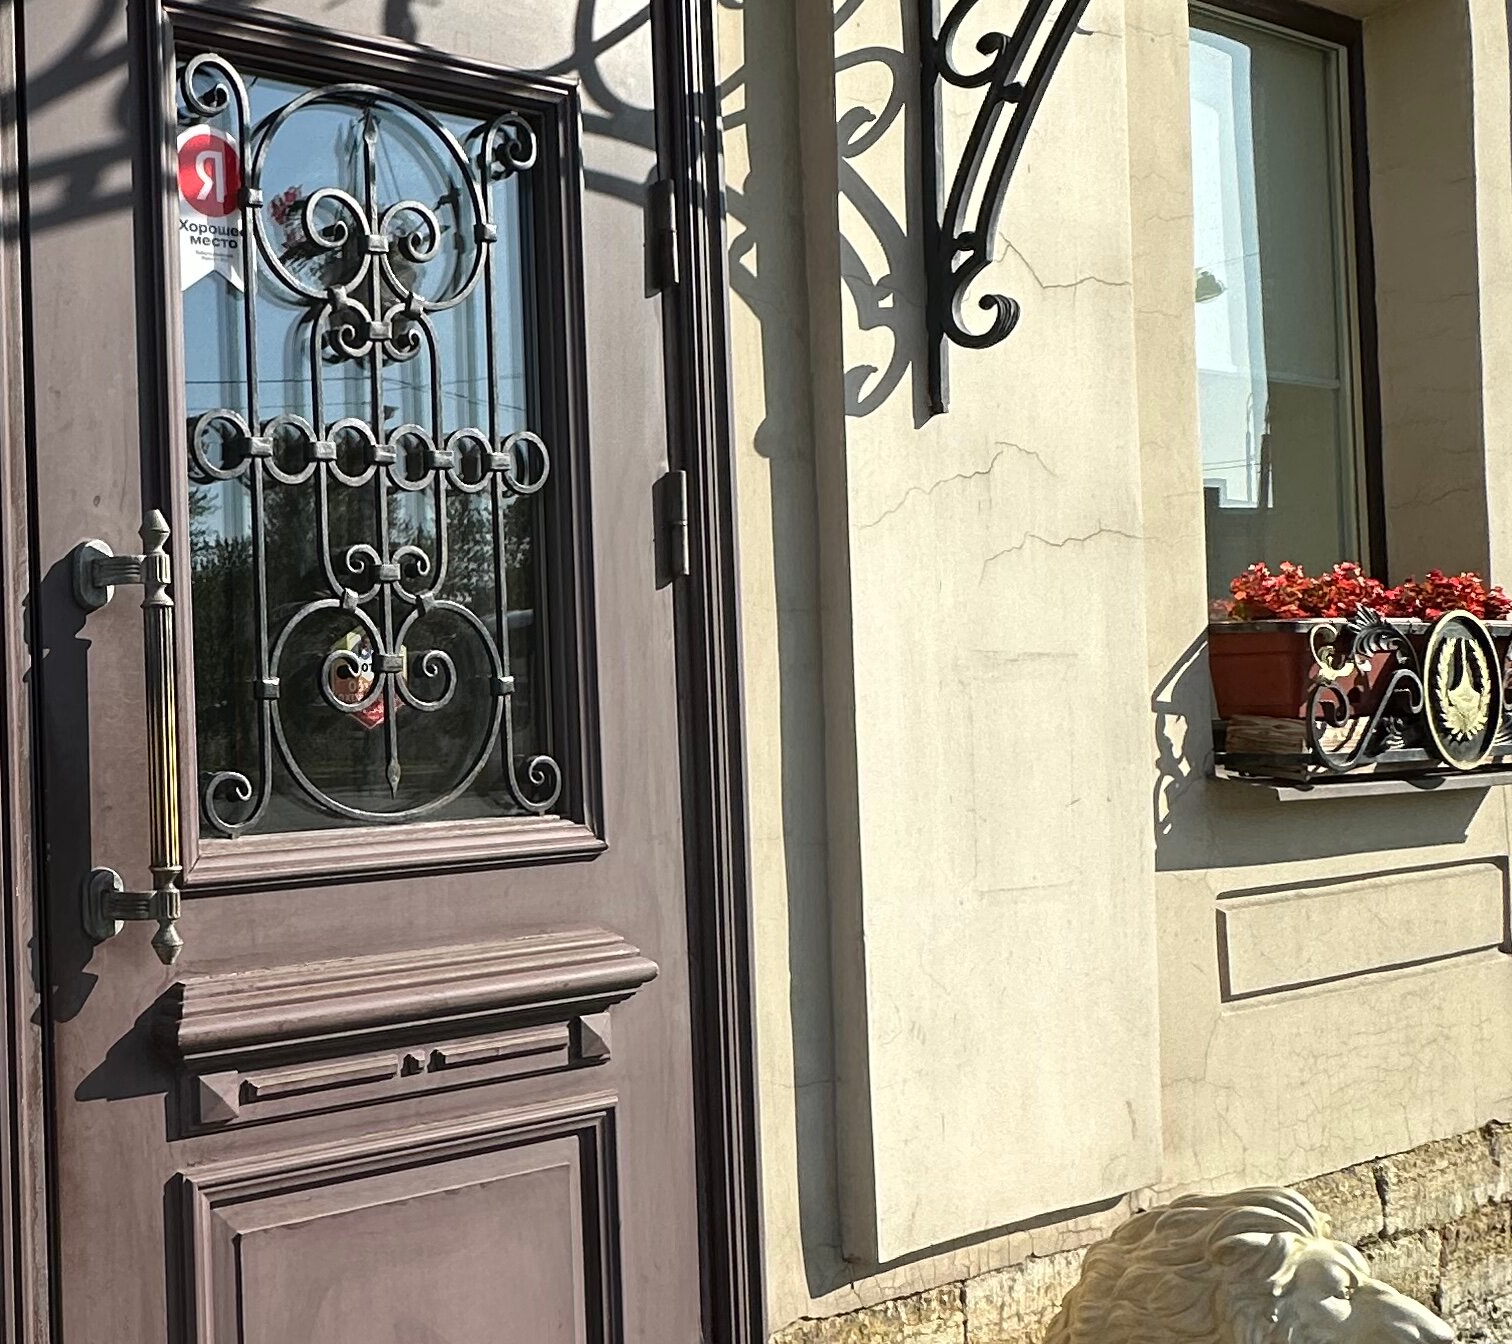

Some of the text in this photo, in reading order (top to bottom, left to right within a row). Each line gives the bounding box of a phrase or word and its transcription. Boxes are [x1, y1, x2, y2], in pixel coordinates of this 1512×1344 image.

[195, 150, 227, 204] Я
[178, 218, 244, 238] Хороше
[189, 235, 239, 249] место
